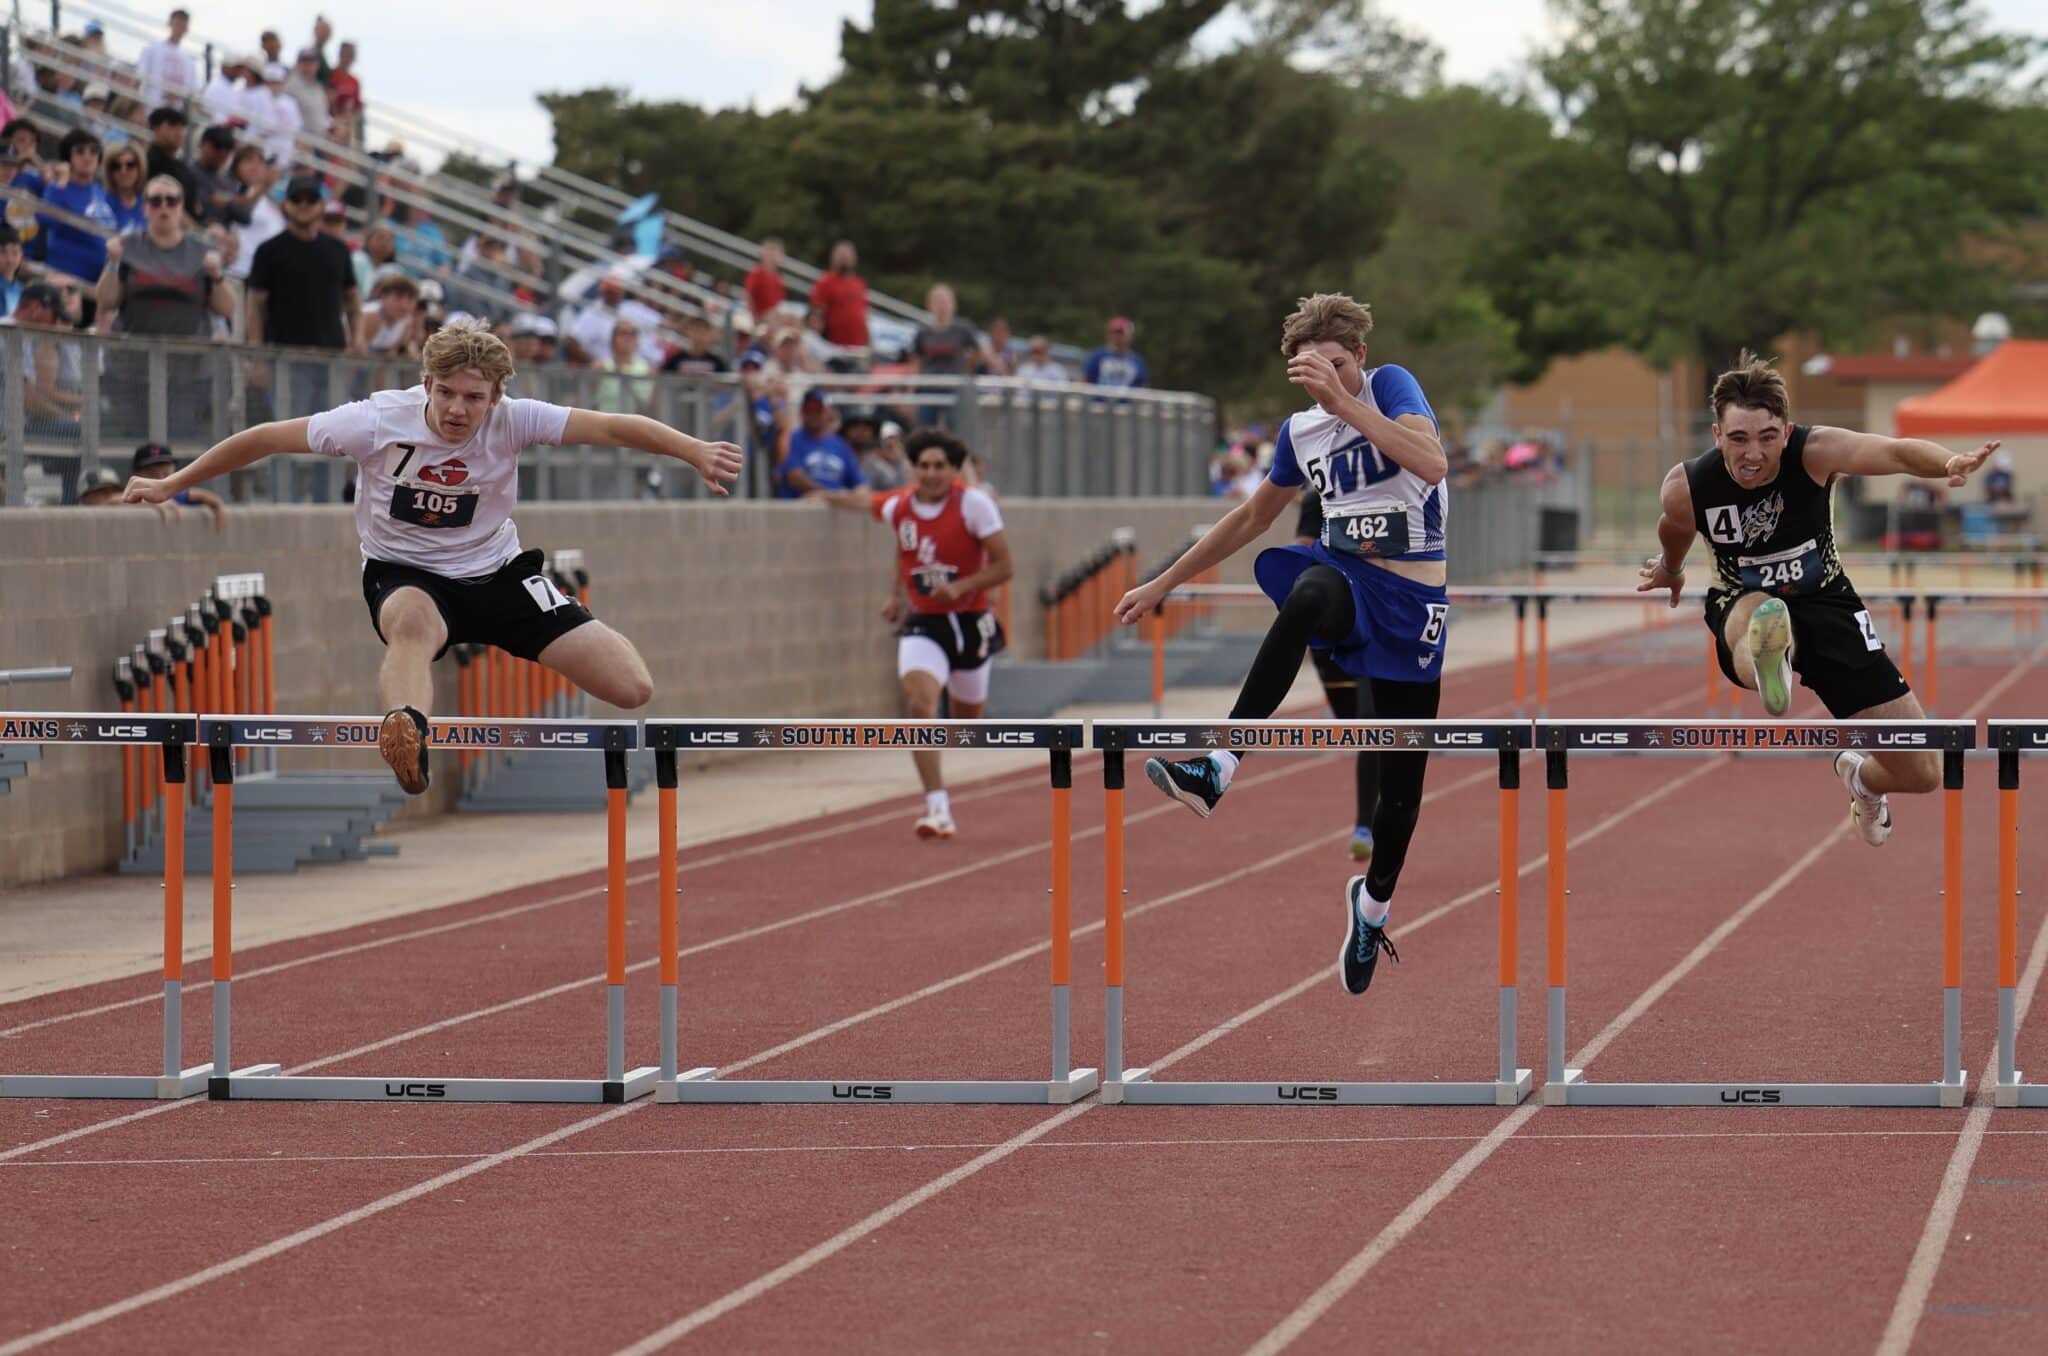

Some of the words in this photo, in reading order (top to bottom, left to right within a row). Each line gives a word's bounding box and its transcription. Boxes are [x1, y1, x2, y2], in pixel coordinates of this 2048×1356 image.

[393, 443, 416, 477] 7
[1307, 457, 1327, 494] 5
[412, 491, 459, 514] 105
[1346, 516, 1389, 540] 462
[1713, 508, 1737, 541] 4
[1759, 560, 1804, 587] 248
[530, 577, 557, 606] 7
[1427, 606, 1446, 641] 5
[0, 720, 60, 739] AINS
[98, 725, 148, 737] UCS
[244, 728, 293, 740] UCS
[336, 724, 380, 743] SOU
[425, 726, 501, 745] LAINS
[540, 732, 589, 744] UCS
[690, 731, 739, 743] UCS
[782, 727, 857, 746] SOUTH
[863, 727, 948, 746] PLAINS
[986, 731, 1035, 744] UCS
[1138, 732, 1187, 744] UCS
[1229, 728, 1305, 747] SOUTH
[1310, 728, 1396, 747] PLAINS
[1434, 732, 1483, 744] UCS
[1579, 732, 1629, 744] UCS
[1671, 728, 1749, 747] SOUTH
[1753, 728, 1838, 747] PLAINS
[1878, 733, 1927, 744] UCS
[385, 1084, 446, 1097] UCS
[832, 1085, 892, 1099] UCS
[1278, 1086, 1338, 1100] UCS
[1721, 1090, 1781, 1103] UCS
